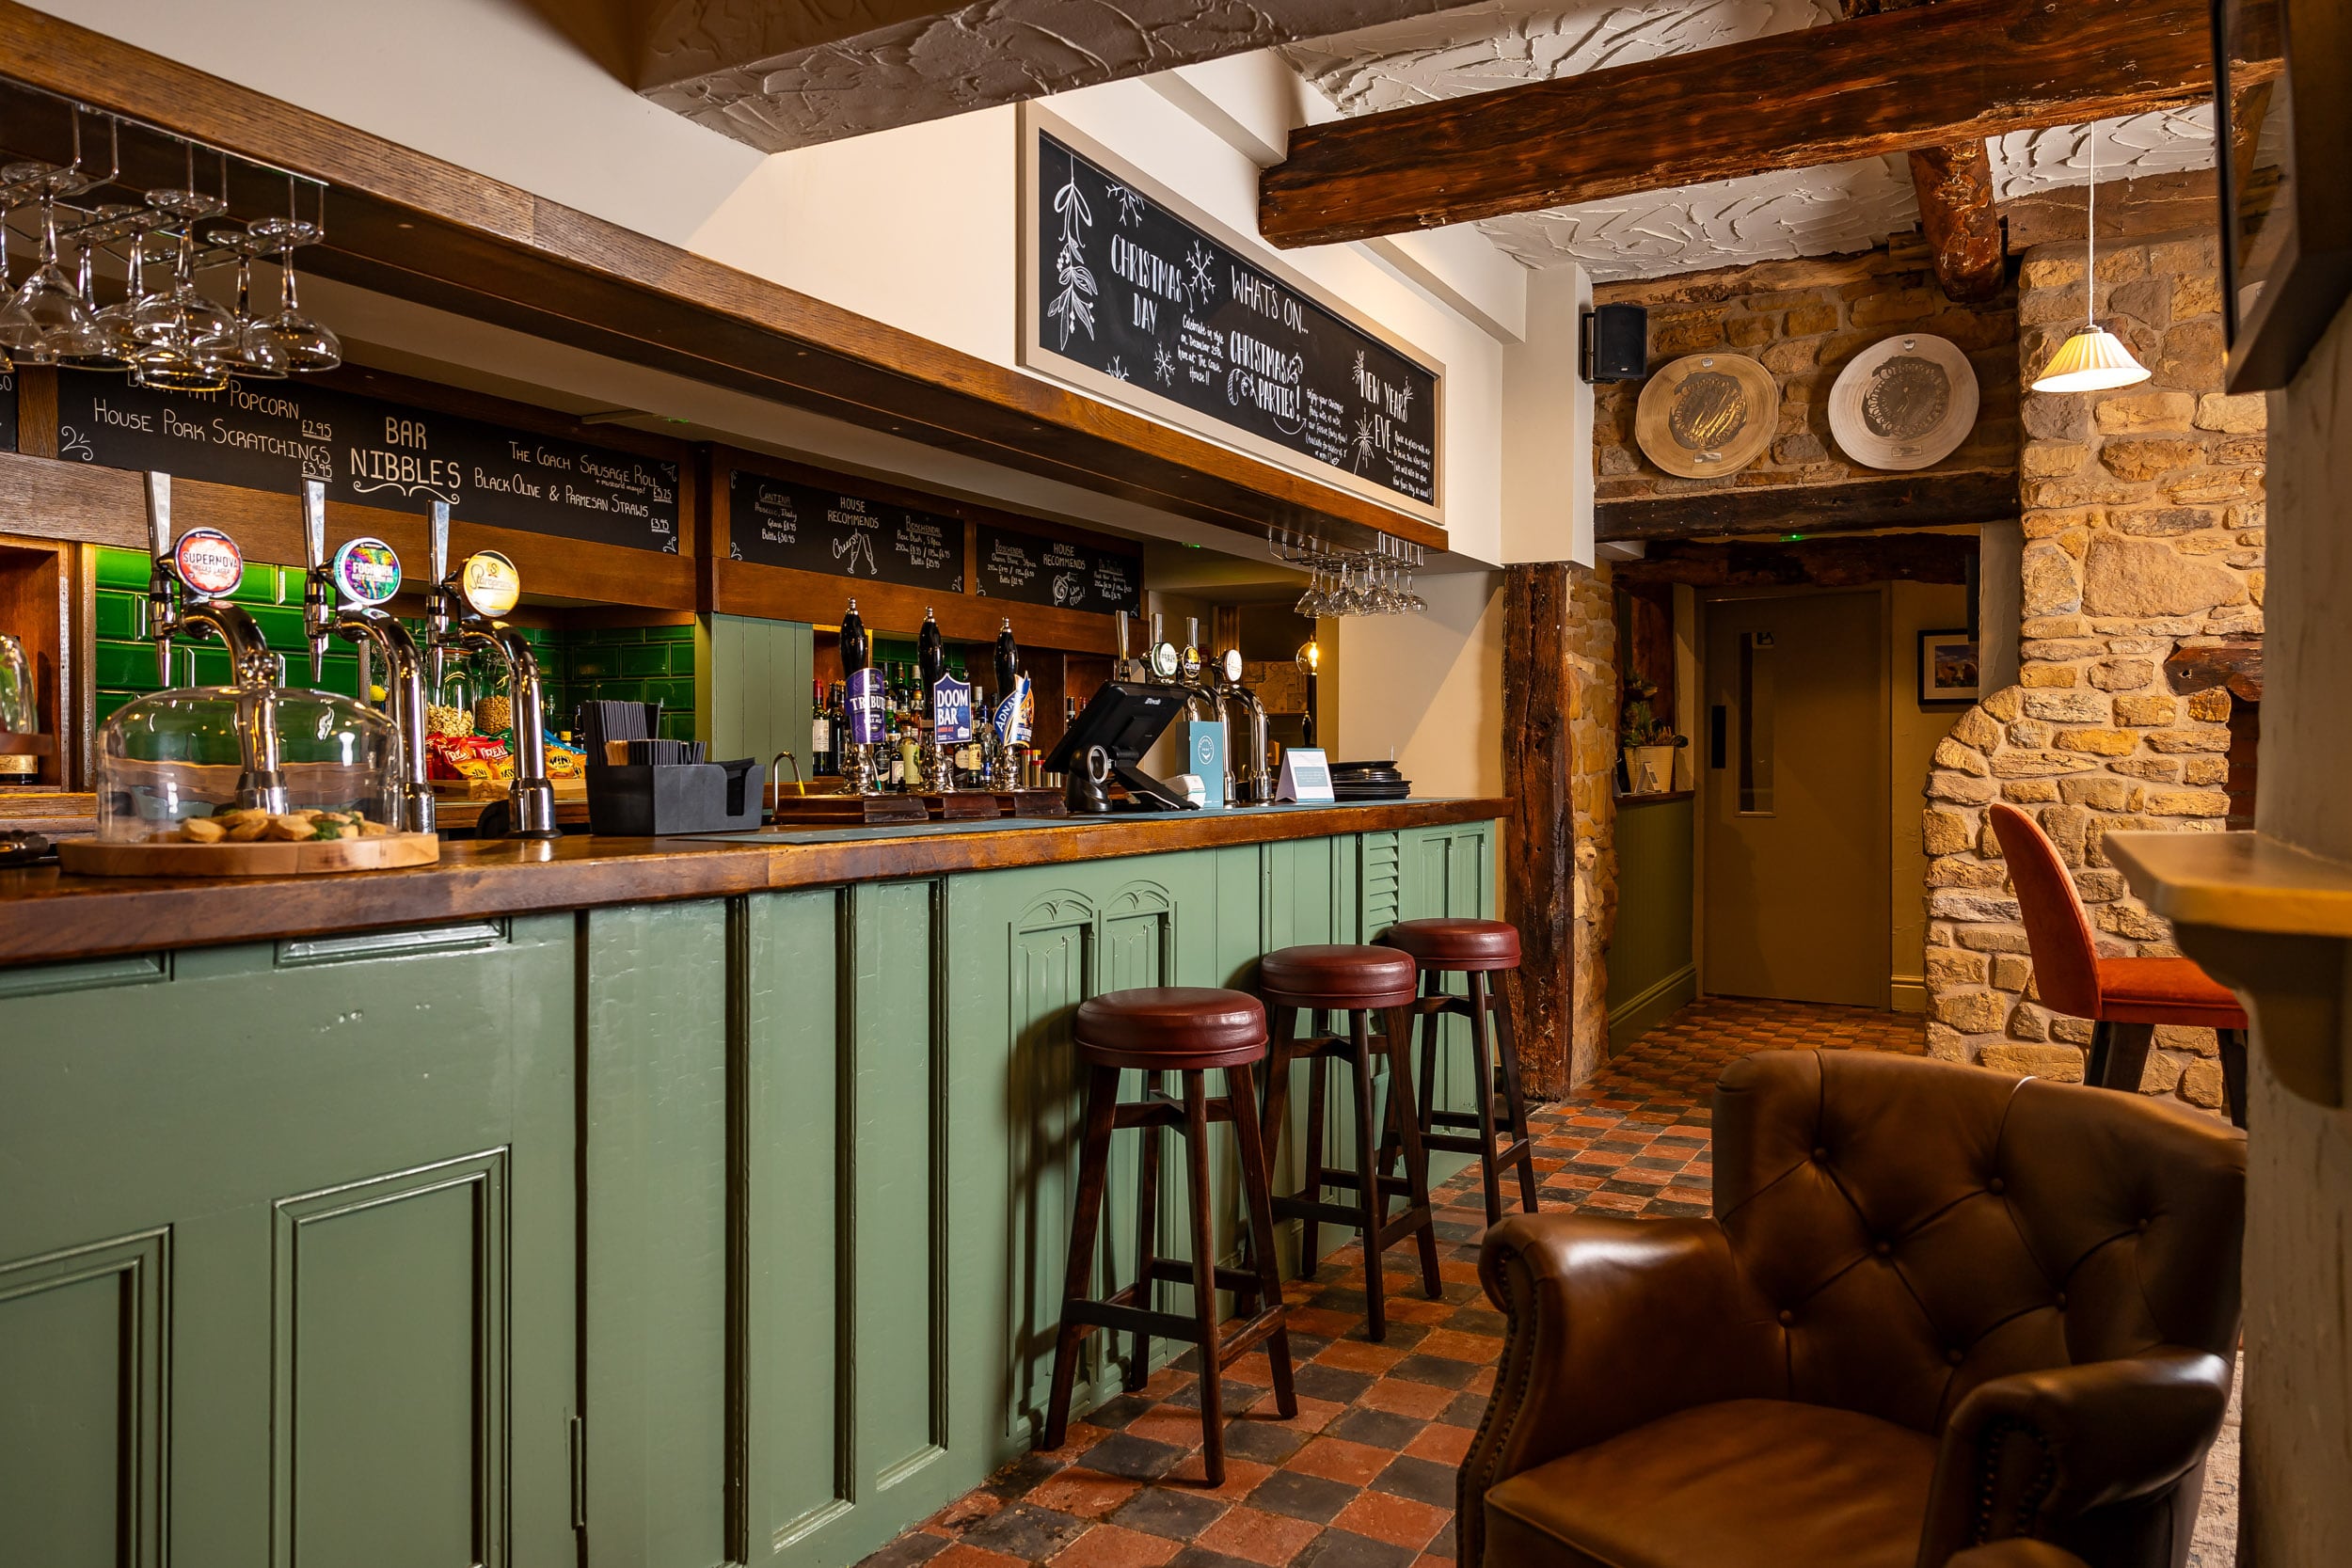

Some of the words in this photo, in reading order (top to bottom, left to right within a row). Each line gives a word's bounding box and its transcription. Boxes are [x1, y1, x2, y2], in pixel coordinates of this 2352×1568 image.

[1111, 234, 1183, 304] CHRISTMAS
[1133, 293, 1158, 335] DAY
[1231, 264, 1279, 320] WHAT'S
[1284, 297, 1309, 334] ON...
[1230, 330, 1288, 385] CHRISTMAS
[230, 380, 299, 420] POPCORN
[1258, 377, 1300, 422] PARTIES!
[1360, 369, 1380, 405] NEW
[94, 397, 153, 433] HOUSE
[164, 408, 205, 441] PORK
[213, 418, 331, 465] SCRATCHINGS
[302, 420, 332, 438] £2.95
[386, 416, 427, 450] BAR
[1375, 414, 1391, 453] EVE
[302, 460, 332, 478] £3.95
[351, 447, 461, 488] NIBBLES
[509, 440, 532, 462] THE
[537, 446, 571, 470] COACH
[580, 454, 629, 483] SAUSAGE
[635, 465, 660, 487] ROLL
[474, 467, 510, 492] BLACK
[513, 473, 541, 498] OLIVE
[549, 485, 560, 501] &
[565, 484, 609, 511] PARMESAN
[612, 494, 648, 517] STRAWS
[840, 497, 866, 513] HOUSE
[827, 509, 880, 529] RECOMMENDS
[183, 551, 238, 568] SUPERNOVA
[1042, 553, 1086, 570] RECOMMENDS
[1053, 542, 1074, 556] HOUSE
[937, 689, 968, 707] DOOM
[937, 707, 959, 725] BAR
